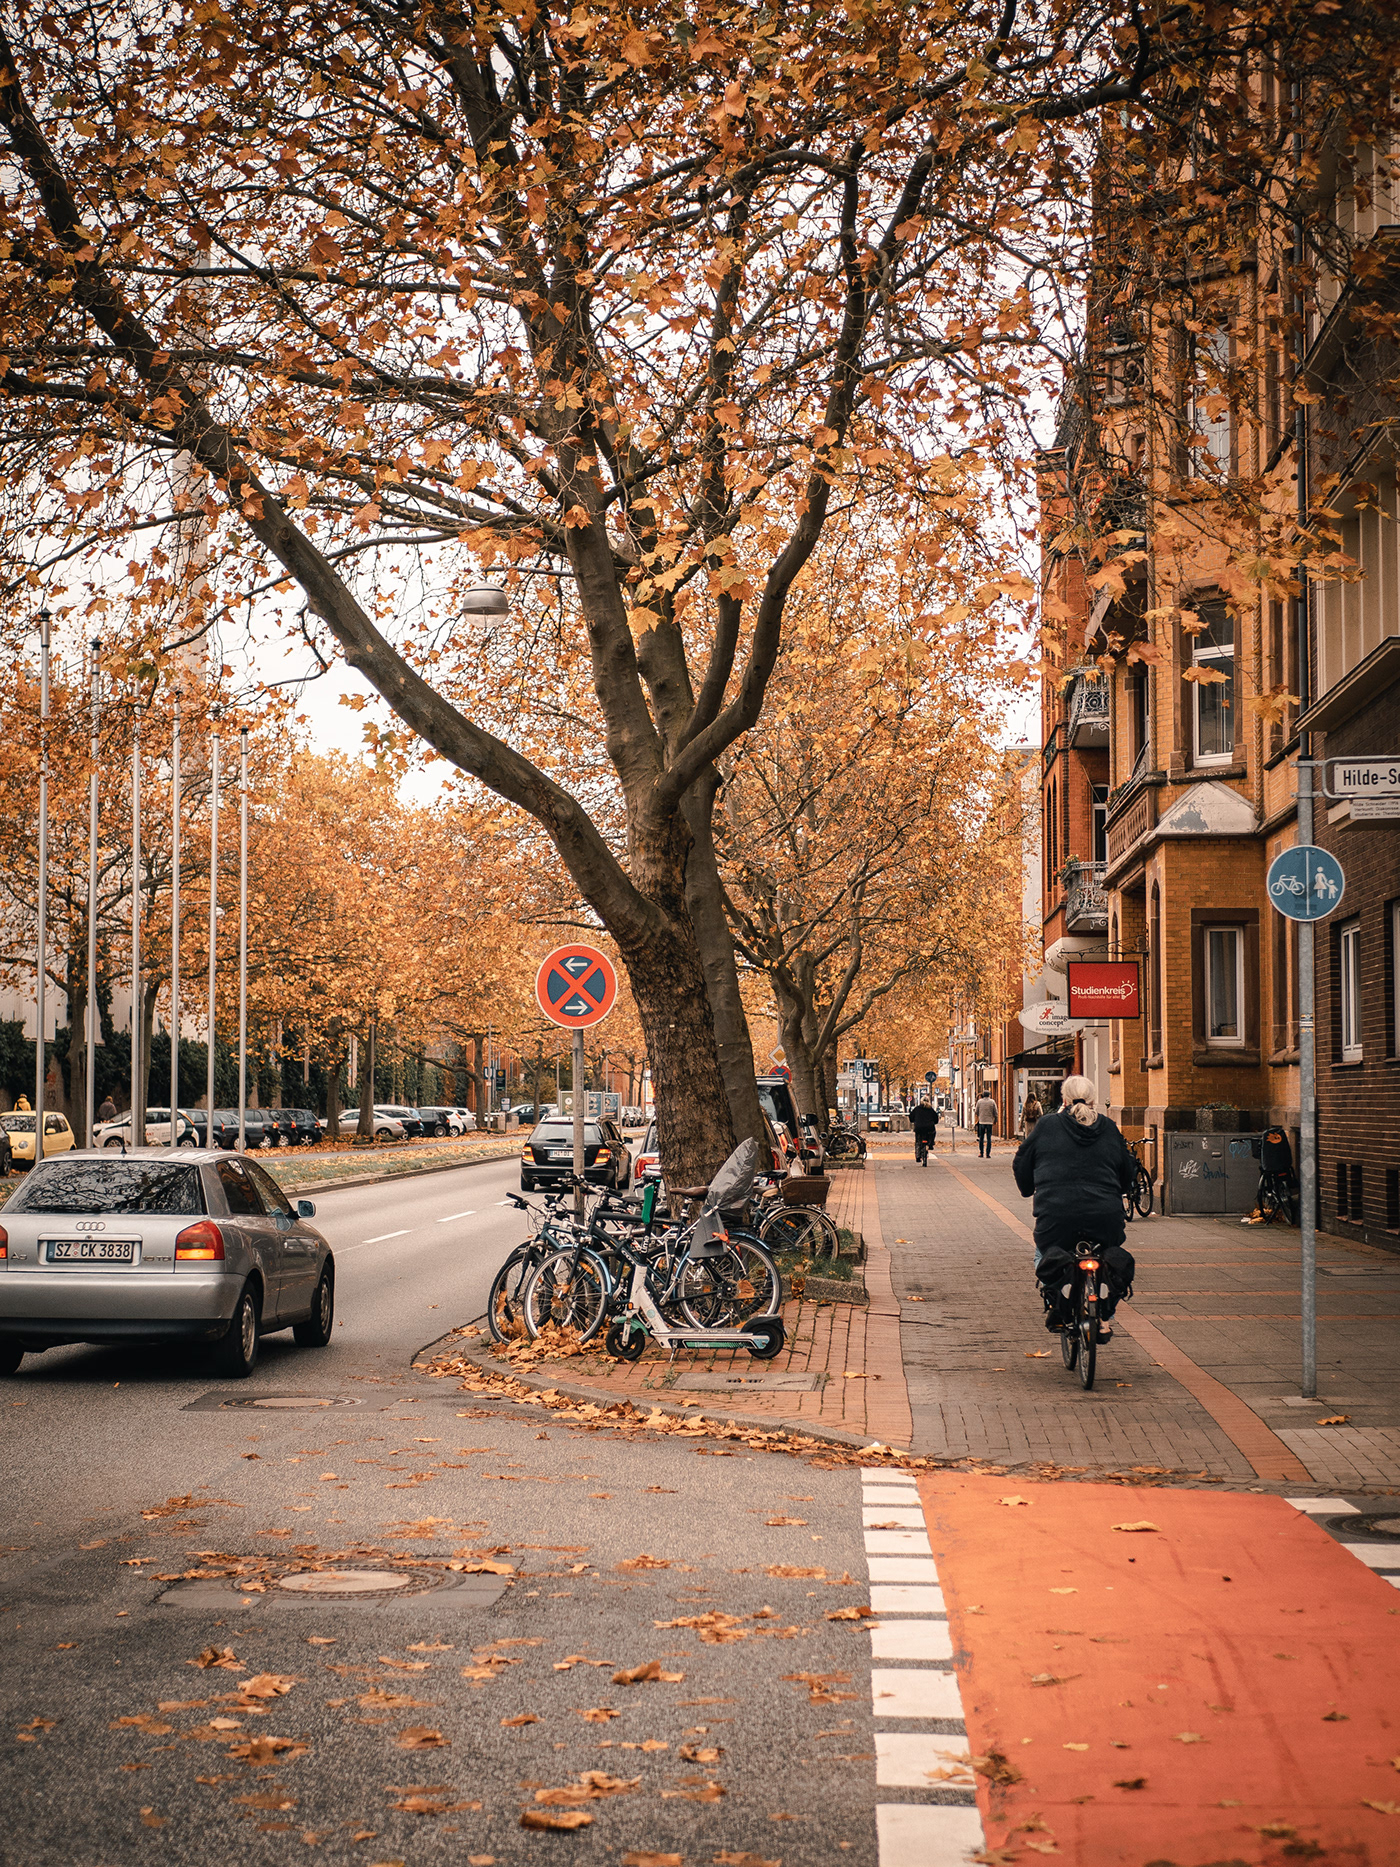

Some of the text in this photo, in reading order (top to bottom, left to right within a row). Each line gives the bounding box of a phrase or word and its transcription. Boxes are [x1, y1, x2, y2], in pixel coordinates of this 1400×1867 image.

[1071, 986, 1126, 995] Studienkreis
[1051, 1014, 1069, 1022] imag
[864, 1068, 872, 1078] U
[56, 1243, 131, 1257] SZ CK 3838
